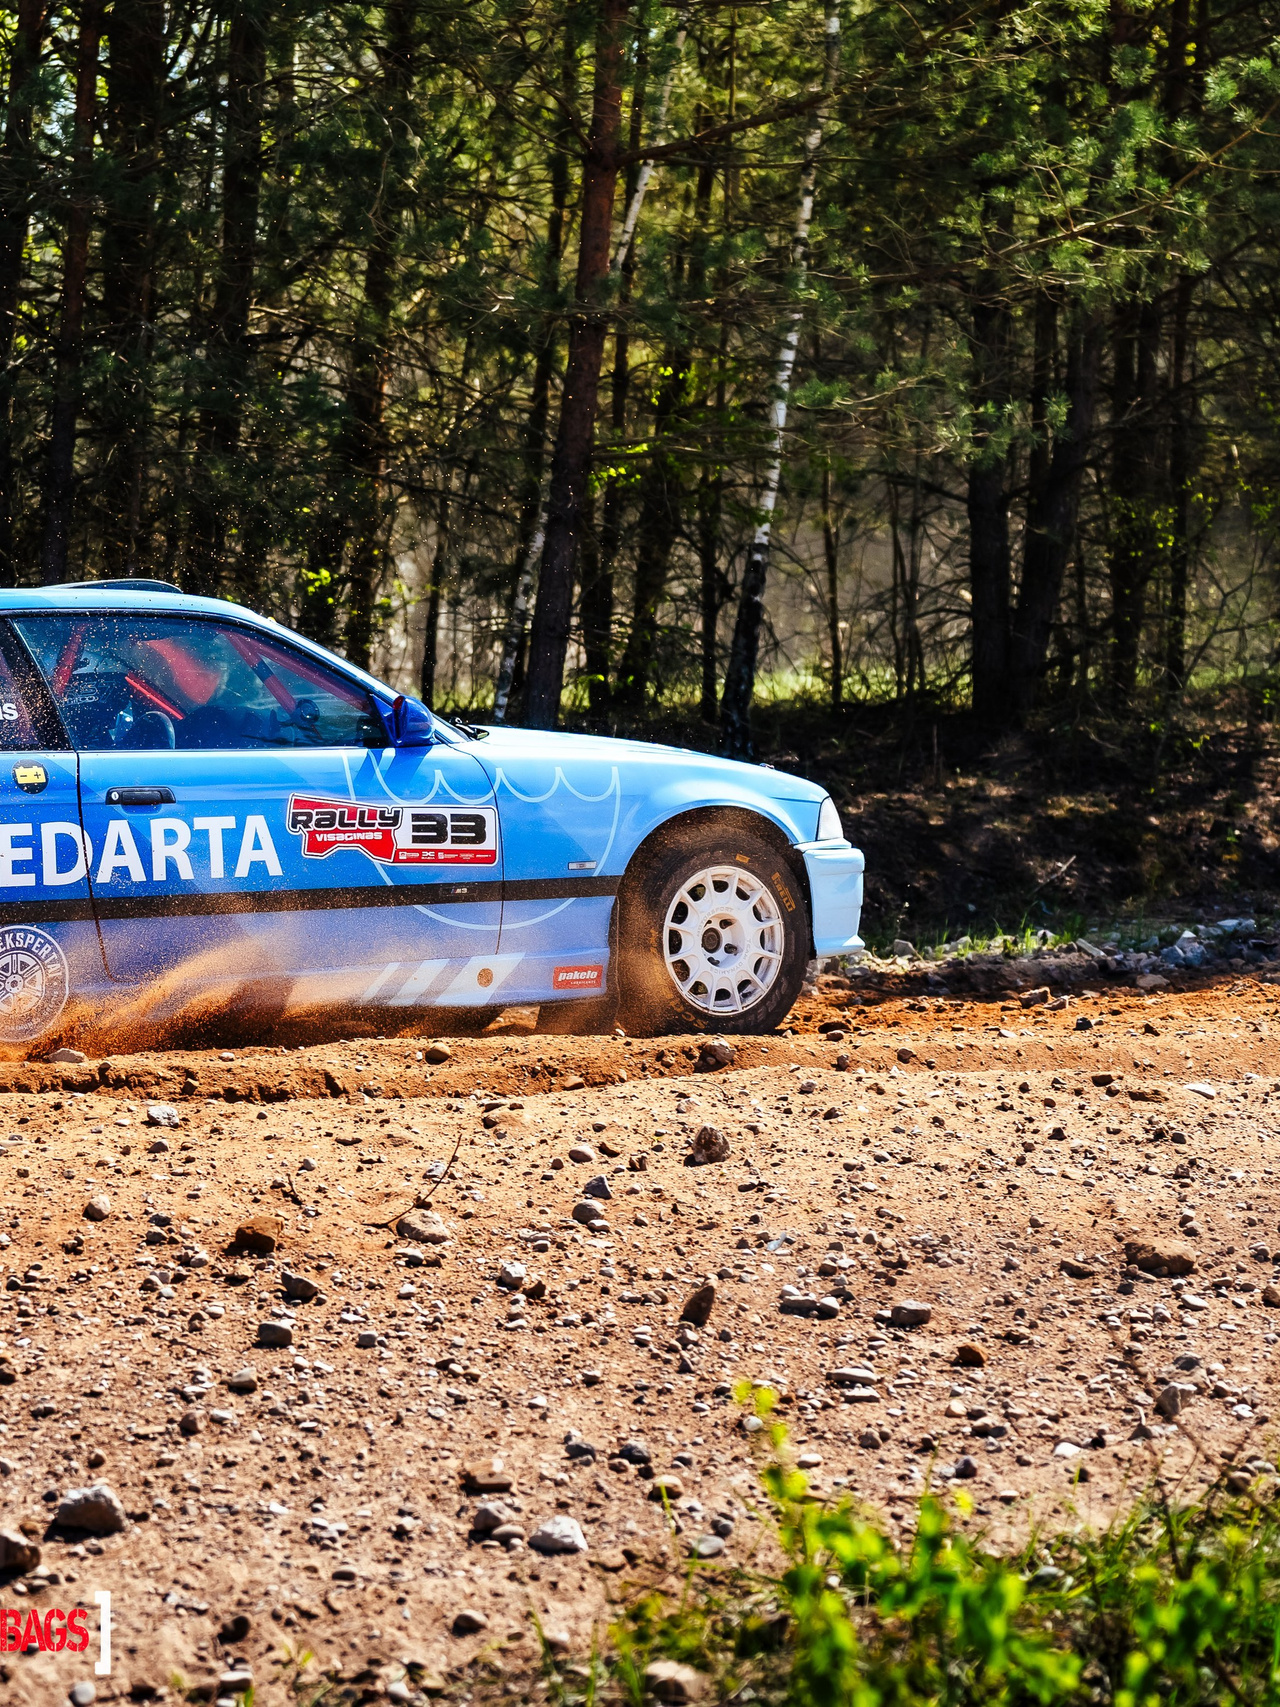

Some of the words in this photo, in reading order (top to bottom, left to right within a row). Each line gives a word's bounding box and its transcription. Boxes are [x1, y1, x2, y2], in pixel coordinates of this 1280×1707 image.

[291, 808, 401, 829] RALLY
[315, 831, 383, 842] VISAGINAS
[411, 813, 487, 845] 33
[558, 970, 598, 981] pakelo
